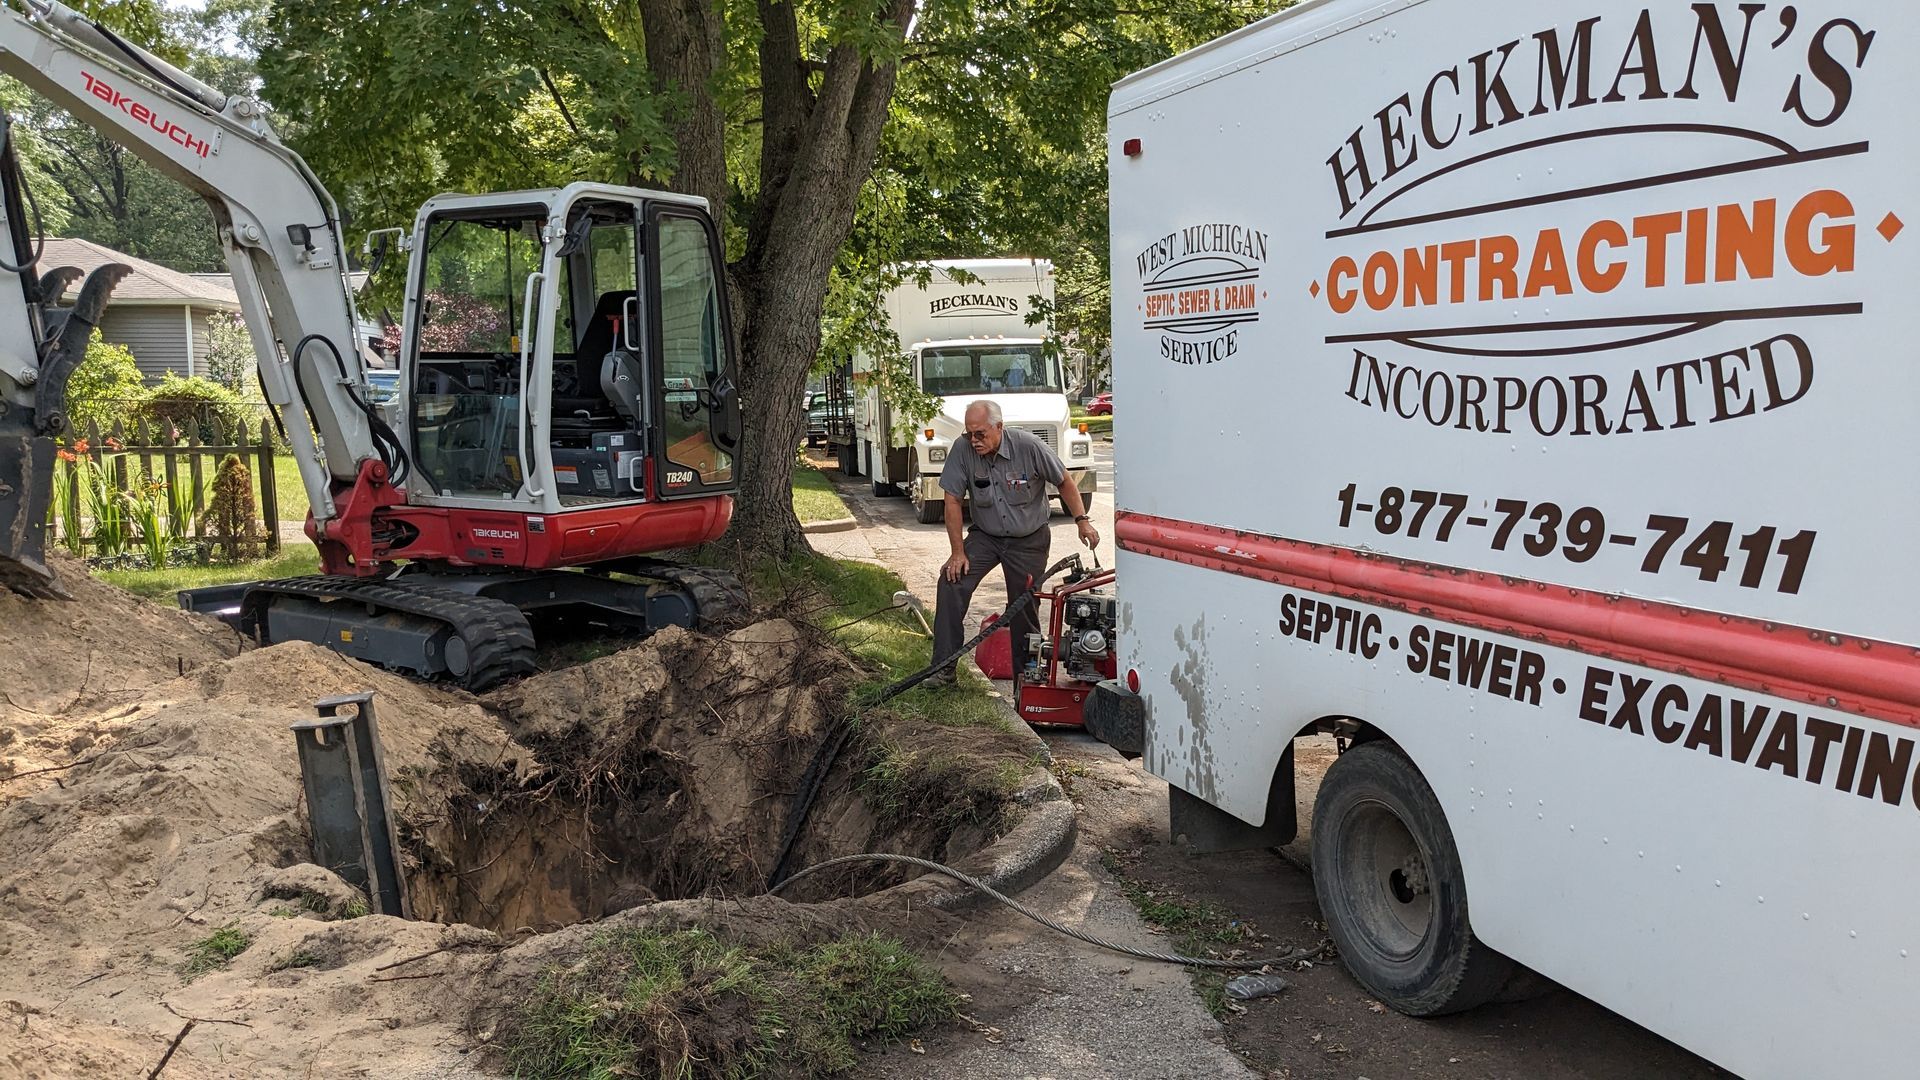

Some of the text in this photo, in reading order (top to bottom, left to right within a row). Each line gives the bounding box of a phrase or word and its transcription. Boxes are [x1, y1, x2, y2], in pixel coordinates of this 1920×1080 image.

[1325, 3, 1877, 220] HECKMAN'S
[1137, 223, 1268, 280] WEST MICHIGAN
[1326, 189, 1856, 314] CONTRACTING
[929, 294, 1018, 314] HECKMAN'S
[1146, 284, 1255, 318] SEPTIC SEWER & DRAIN
[1160, 329, 1238, 365] SERVICE
[1344, 333, 1814, 436] INCORPORATED
[666, 471, 693, 484] TB240
[1337, 483, 1817, 595] 1-877-739-7411
[1279, 593, 1920, 812] SEPTIC SEWER EXCAVATIN
